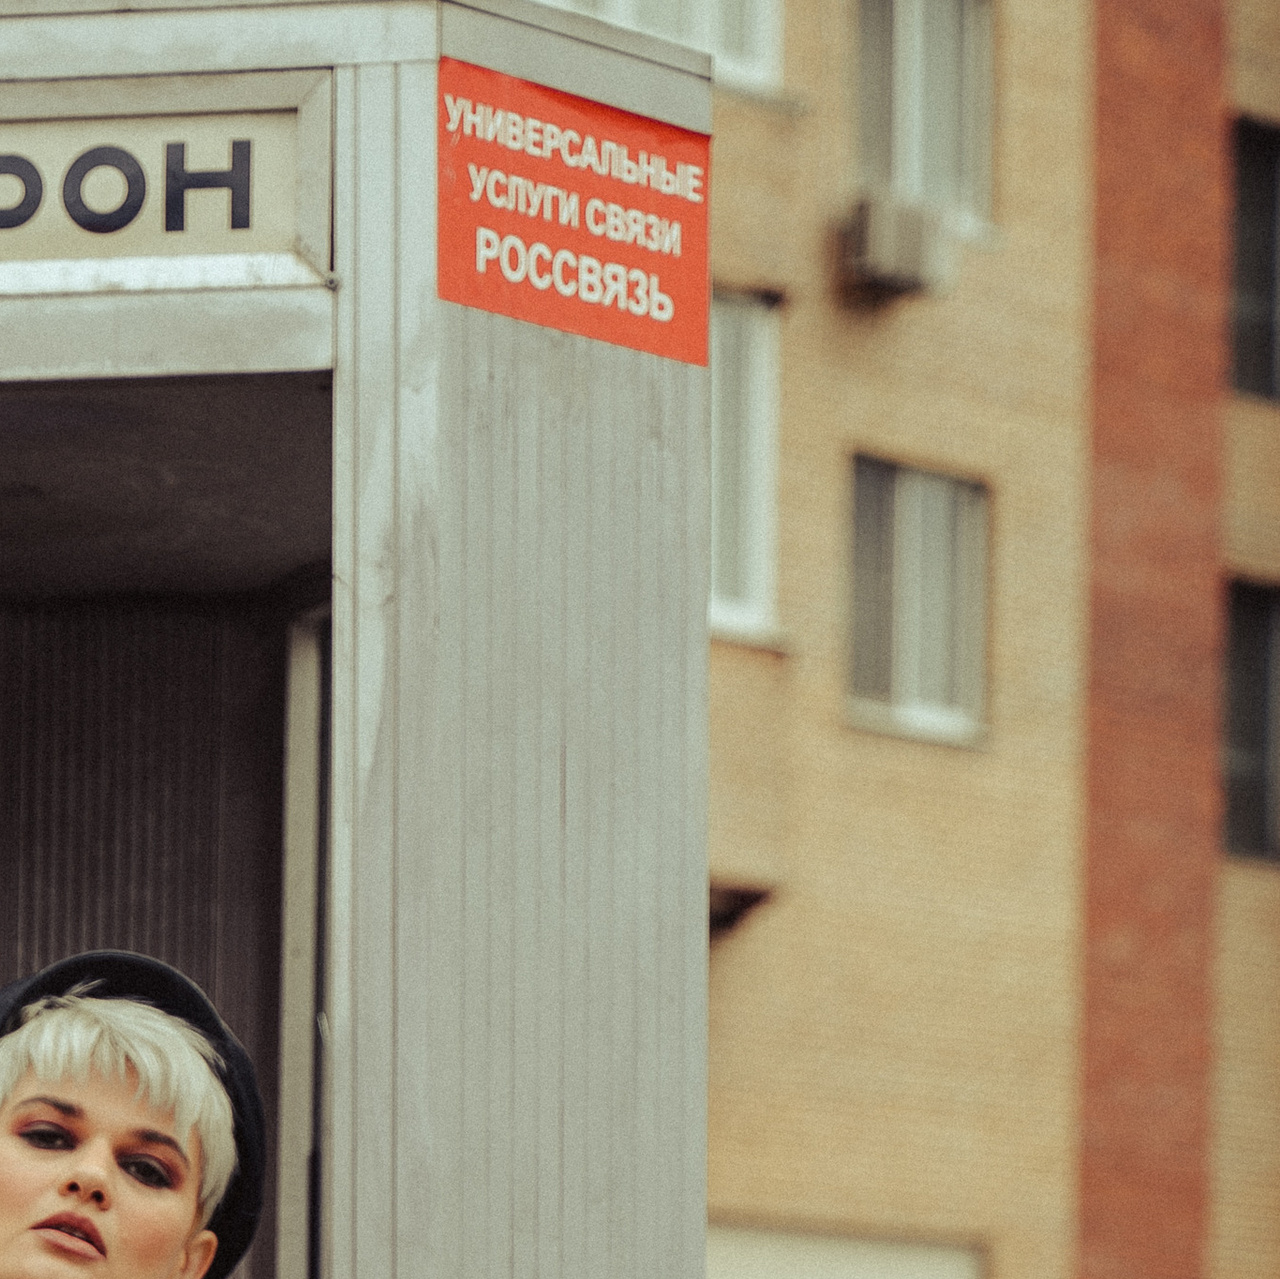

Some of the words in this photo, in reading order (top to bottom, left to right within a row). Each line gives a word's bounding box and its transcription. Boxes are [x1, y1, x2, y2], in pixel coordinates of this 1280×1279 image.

[444, 93, 704, 202] УНИВЕРСАЛЬНЫЕ
[468, 163, 580, 229] УСЛУГИ
[586, 198, 682, 257] СВЯЗИ
[476, 226, 674, 321] РОССВЯЗЬ
